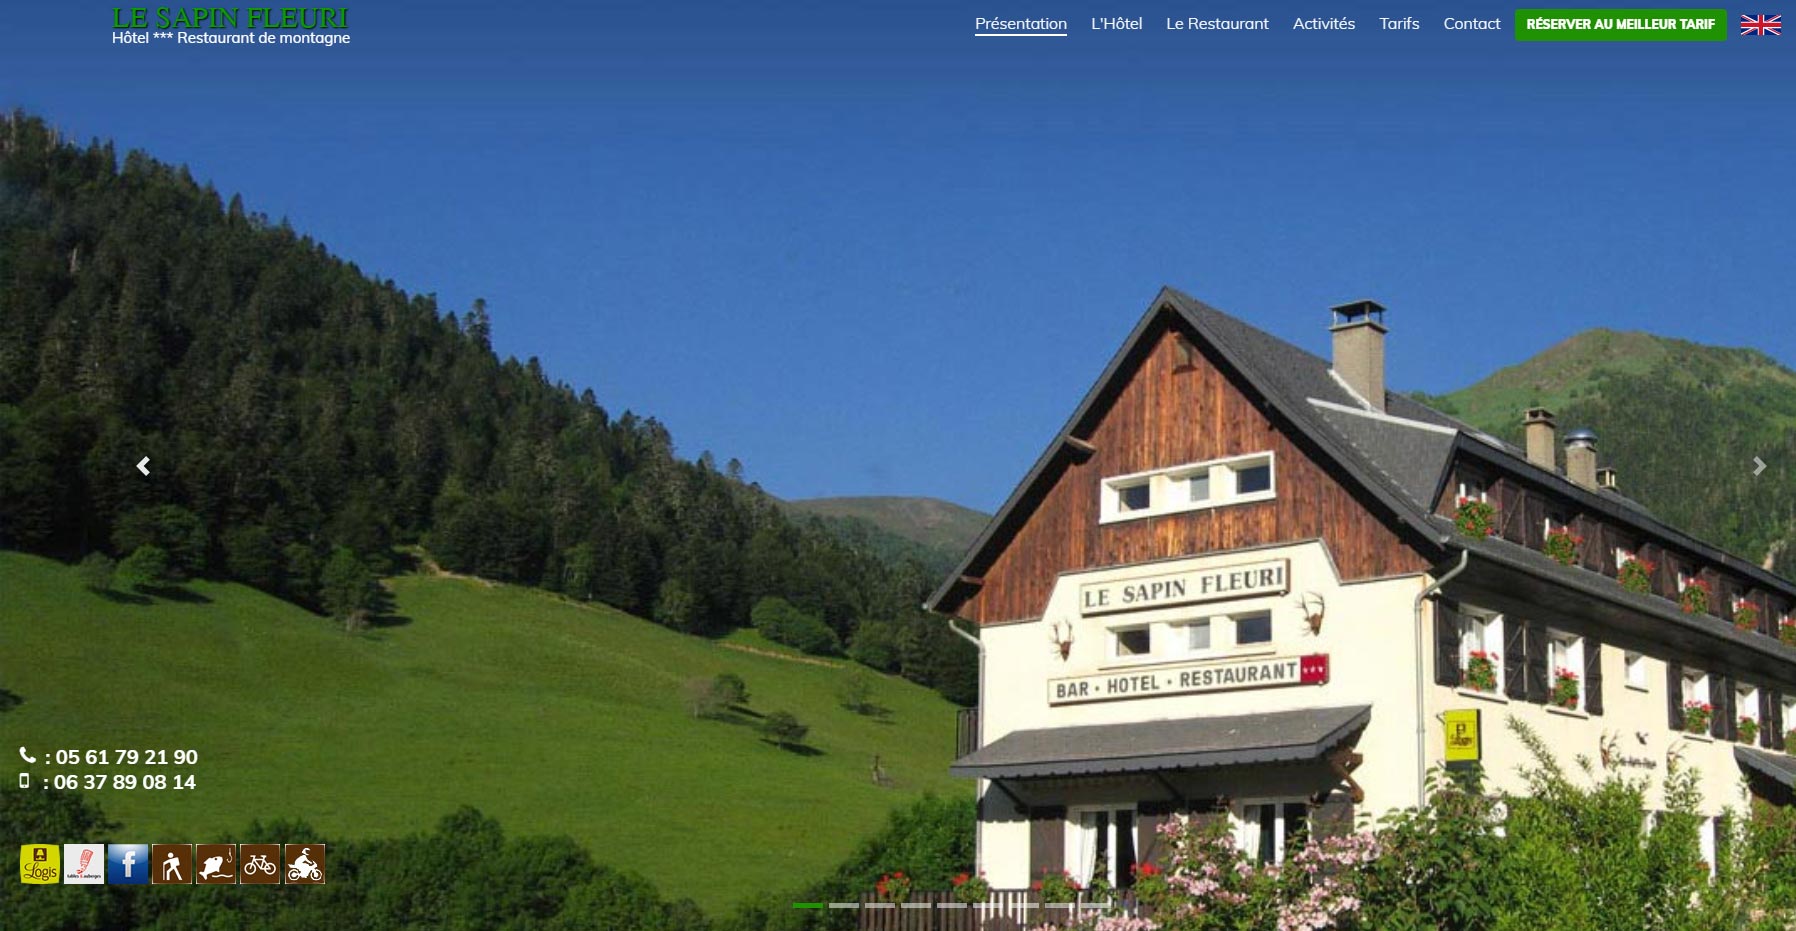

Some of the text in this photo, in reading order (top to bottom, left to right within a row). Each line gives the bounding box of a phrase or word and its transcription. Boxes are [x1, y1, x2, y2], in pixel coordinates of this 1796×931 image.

[1084, 566, 1283, 608] LE SAPIN FLEURI
[1056, 661, 1298, 699] BAR HOTEL RESTAURANT
